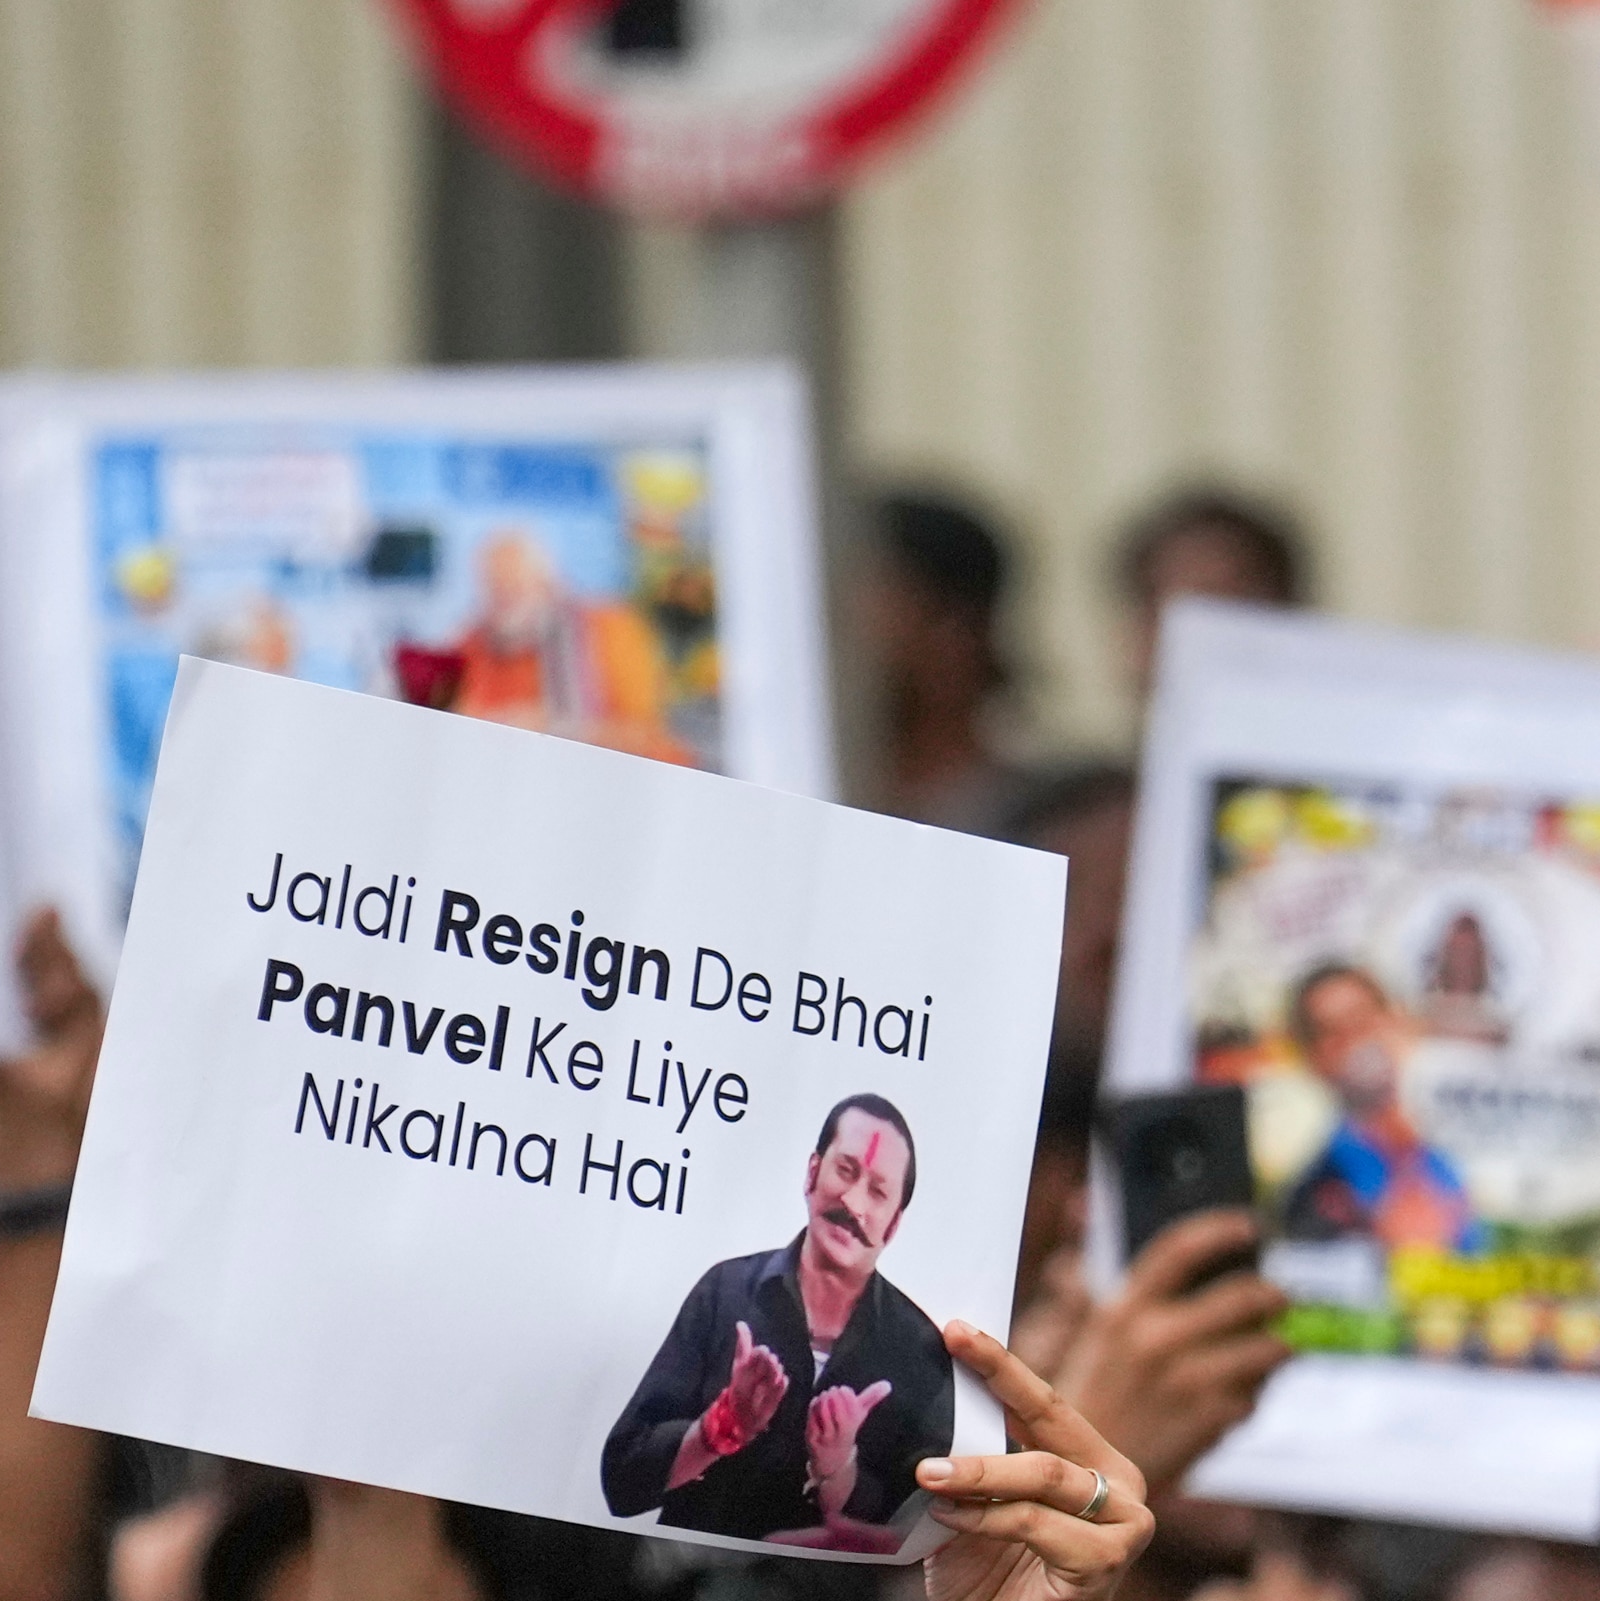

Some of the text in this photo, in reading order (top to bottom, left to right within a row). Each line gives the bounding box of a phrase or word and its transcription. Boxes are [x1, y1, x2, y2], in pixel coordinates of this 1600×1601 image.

[246, 852, 930, 1063] Jaldi Resign De Bhai
[257, 958, 750, 1135] Panvel Ke Liye
[294, 1071, 692, 1216] Nikalna Hai
